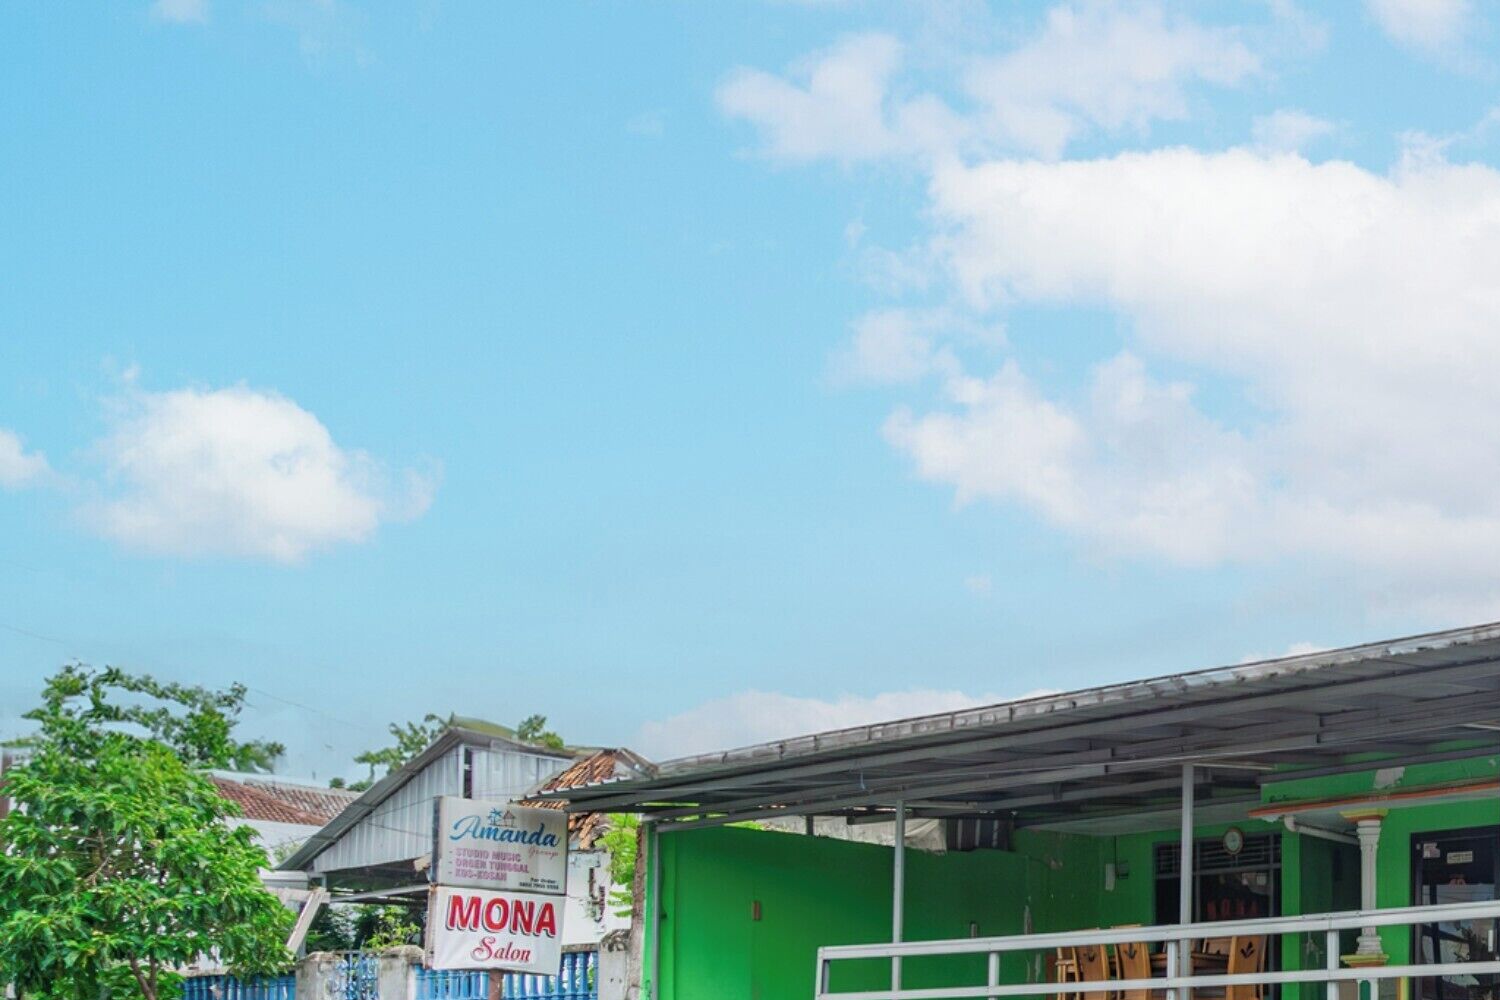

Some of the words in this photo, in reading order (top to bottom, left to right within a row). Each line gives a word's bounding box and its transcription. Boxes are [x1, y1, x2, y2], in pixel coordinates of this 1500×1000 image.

[449, 815, 561, 848] Amanda
[455, 847, 489, 859] STUDIO
[491, 850, 521, 862] MUSIC
[446, 894, 557, 938] MONA
[471, 936, 531, 963] Salon
